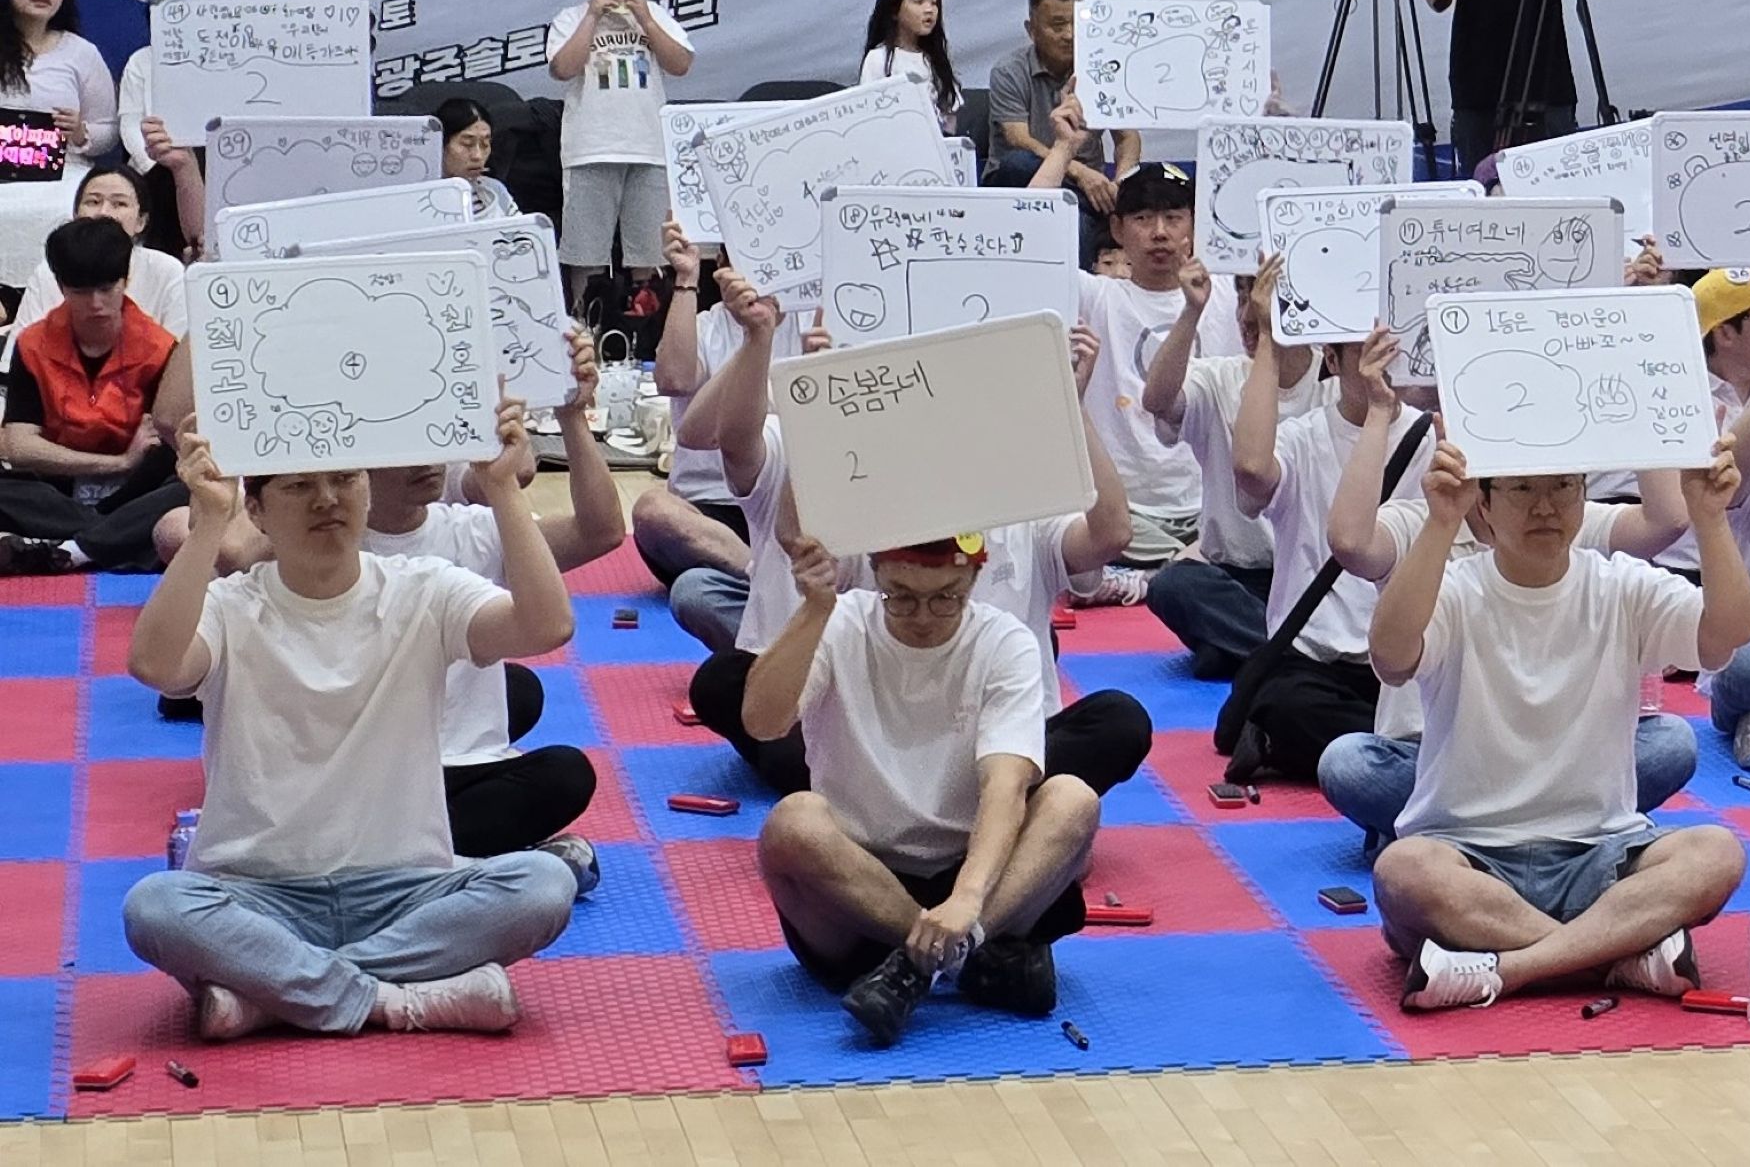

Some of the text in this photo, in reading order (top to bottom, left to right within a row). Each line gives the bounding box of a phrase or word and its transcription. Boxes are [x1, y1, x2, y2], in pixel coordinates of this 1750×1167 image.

[245, 71, 281, 104] 2
[1154, 63, 1174, 84] 2
[220, 134, 246, 154] 39
[1485, 308, 1536, 334] 1등은
[205, 317, 257, 431] 최고야
[1505, 382, 1535, 412] 2
[845, 451, 869, 482] 2
